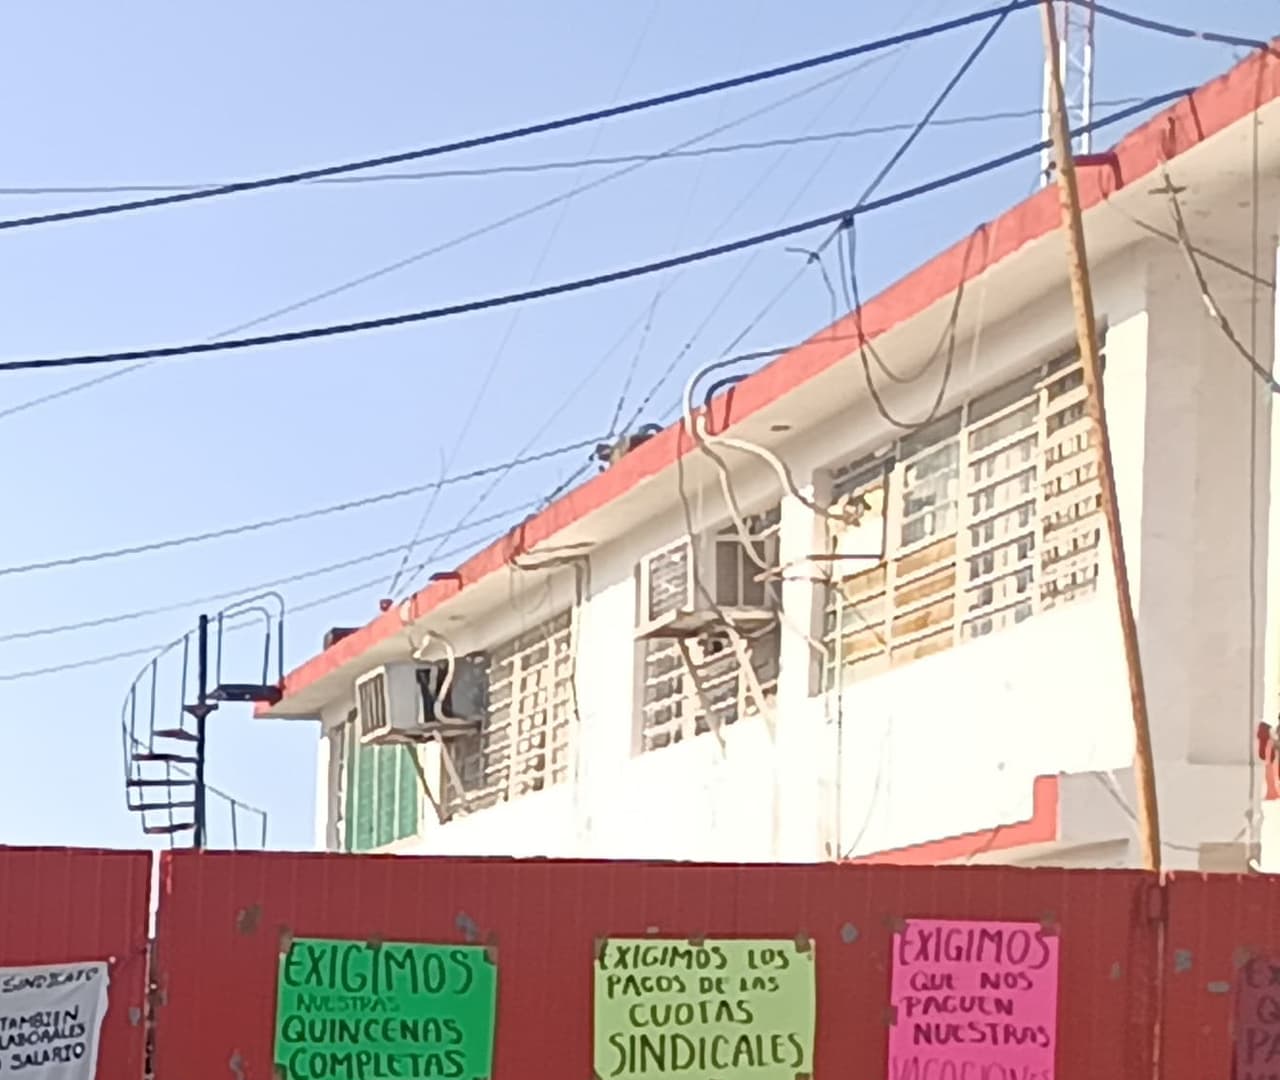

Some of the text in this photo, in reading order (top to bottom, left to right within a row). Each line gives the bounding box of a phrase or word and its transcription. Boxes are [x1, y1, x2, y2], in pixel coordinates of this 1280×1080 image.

[598, 942, 790, 971] EXIGIMOS LOS
[899, 924, 1051, 970] EXIGIMOS
[284, 941, 474, 995] EXIGIMOS
[909, 970, 1034, 991] QUE NOS
[699, 976, 727, 995] DE
[740, 976, 780, 993] LAS
[628, 1000, 754, 1028] CUOTAS
[900, 995, 1015, 1018] PAGUEN
[281, 1015, 464, 1045] QUINCENAS
[913, 1021, 1051, 1048] NUESTRAS
[10, 1042, 86, 1070] SALARIO
[608, 1032, 805, 1078] SINDICALES
